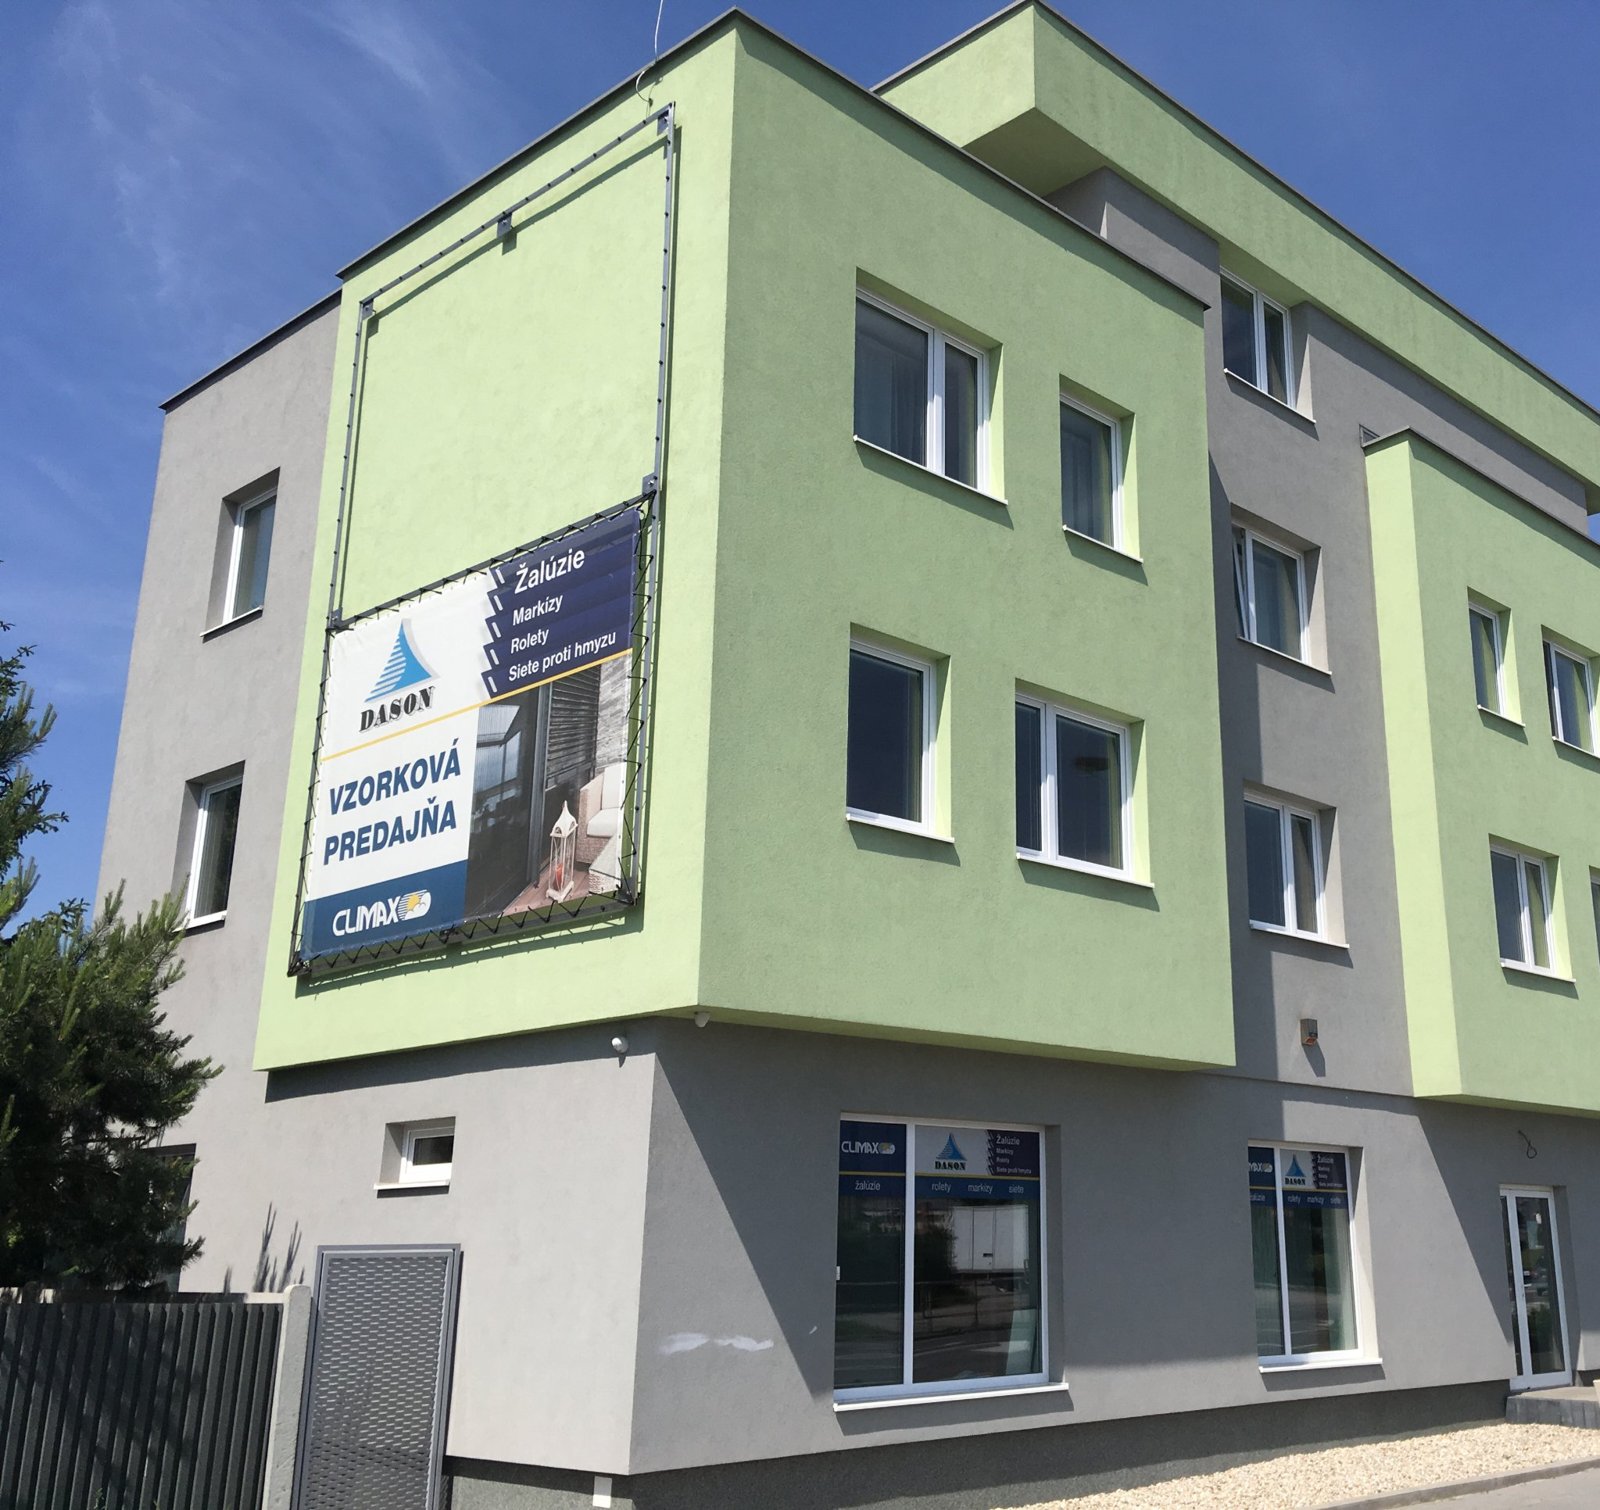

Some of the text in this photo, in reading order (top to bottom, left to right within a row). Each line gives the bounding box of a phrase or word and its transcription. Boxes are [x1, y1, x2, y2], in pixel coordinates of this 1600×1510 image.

[514, 548, 586, 594] Žalúzie
[512, 595, 564, 626] Markízy
[508, 632, 617, 682] Siete proti hmyzu
[510, 629, 550, 654] Rolety
[358, 685, 436, 733] DASON
[329, 738, 462, 816] VZORKOVÁ
[323, 796, 457, 866] PREDAJŇA
[332, 895, 401, 937] CLIMAX
[841, 1141, 879, 1154] CLIMAX
[934, 1160, 967, 1171] DASON
[931, 1181, 952, 1193] rolety
